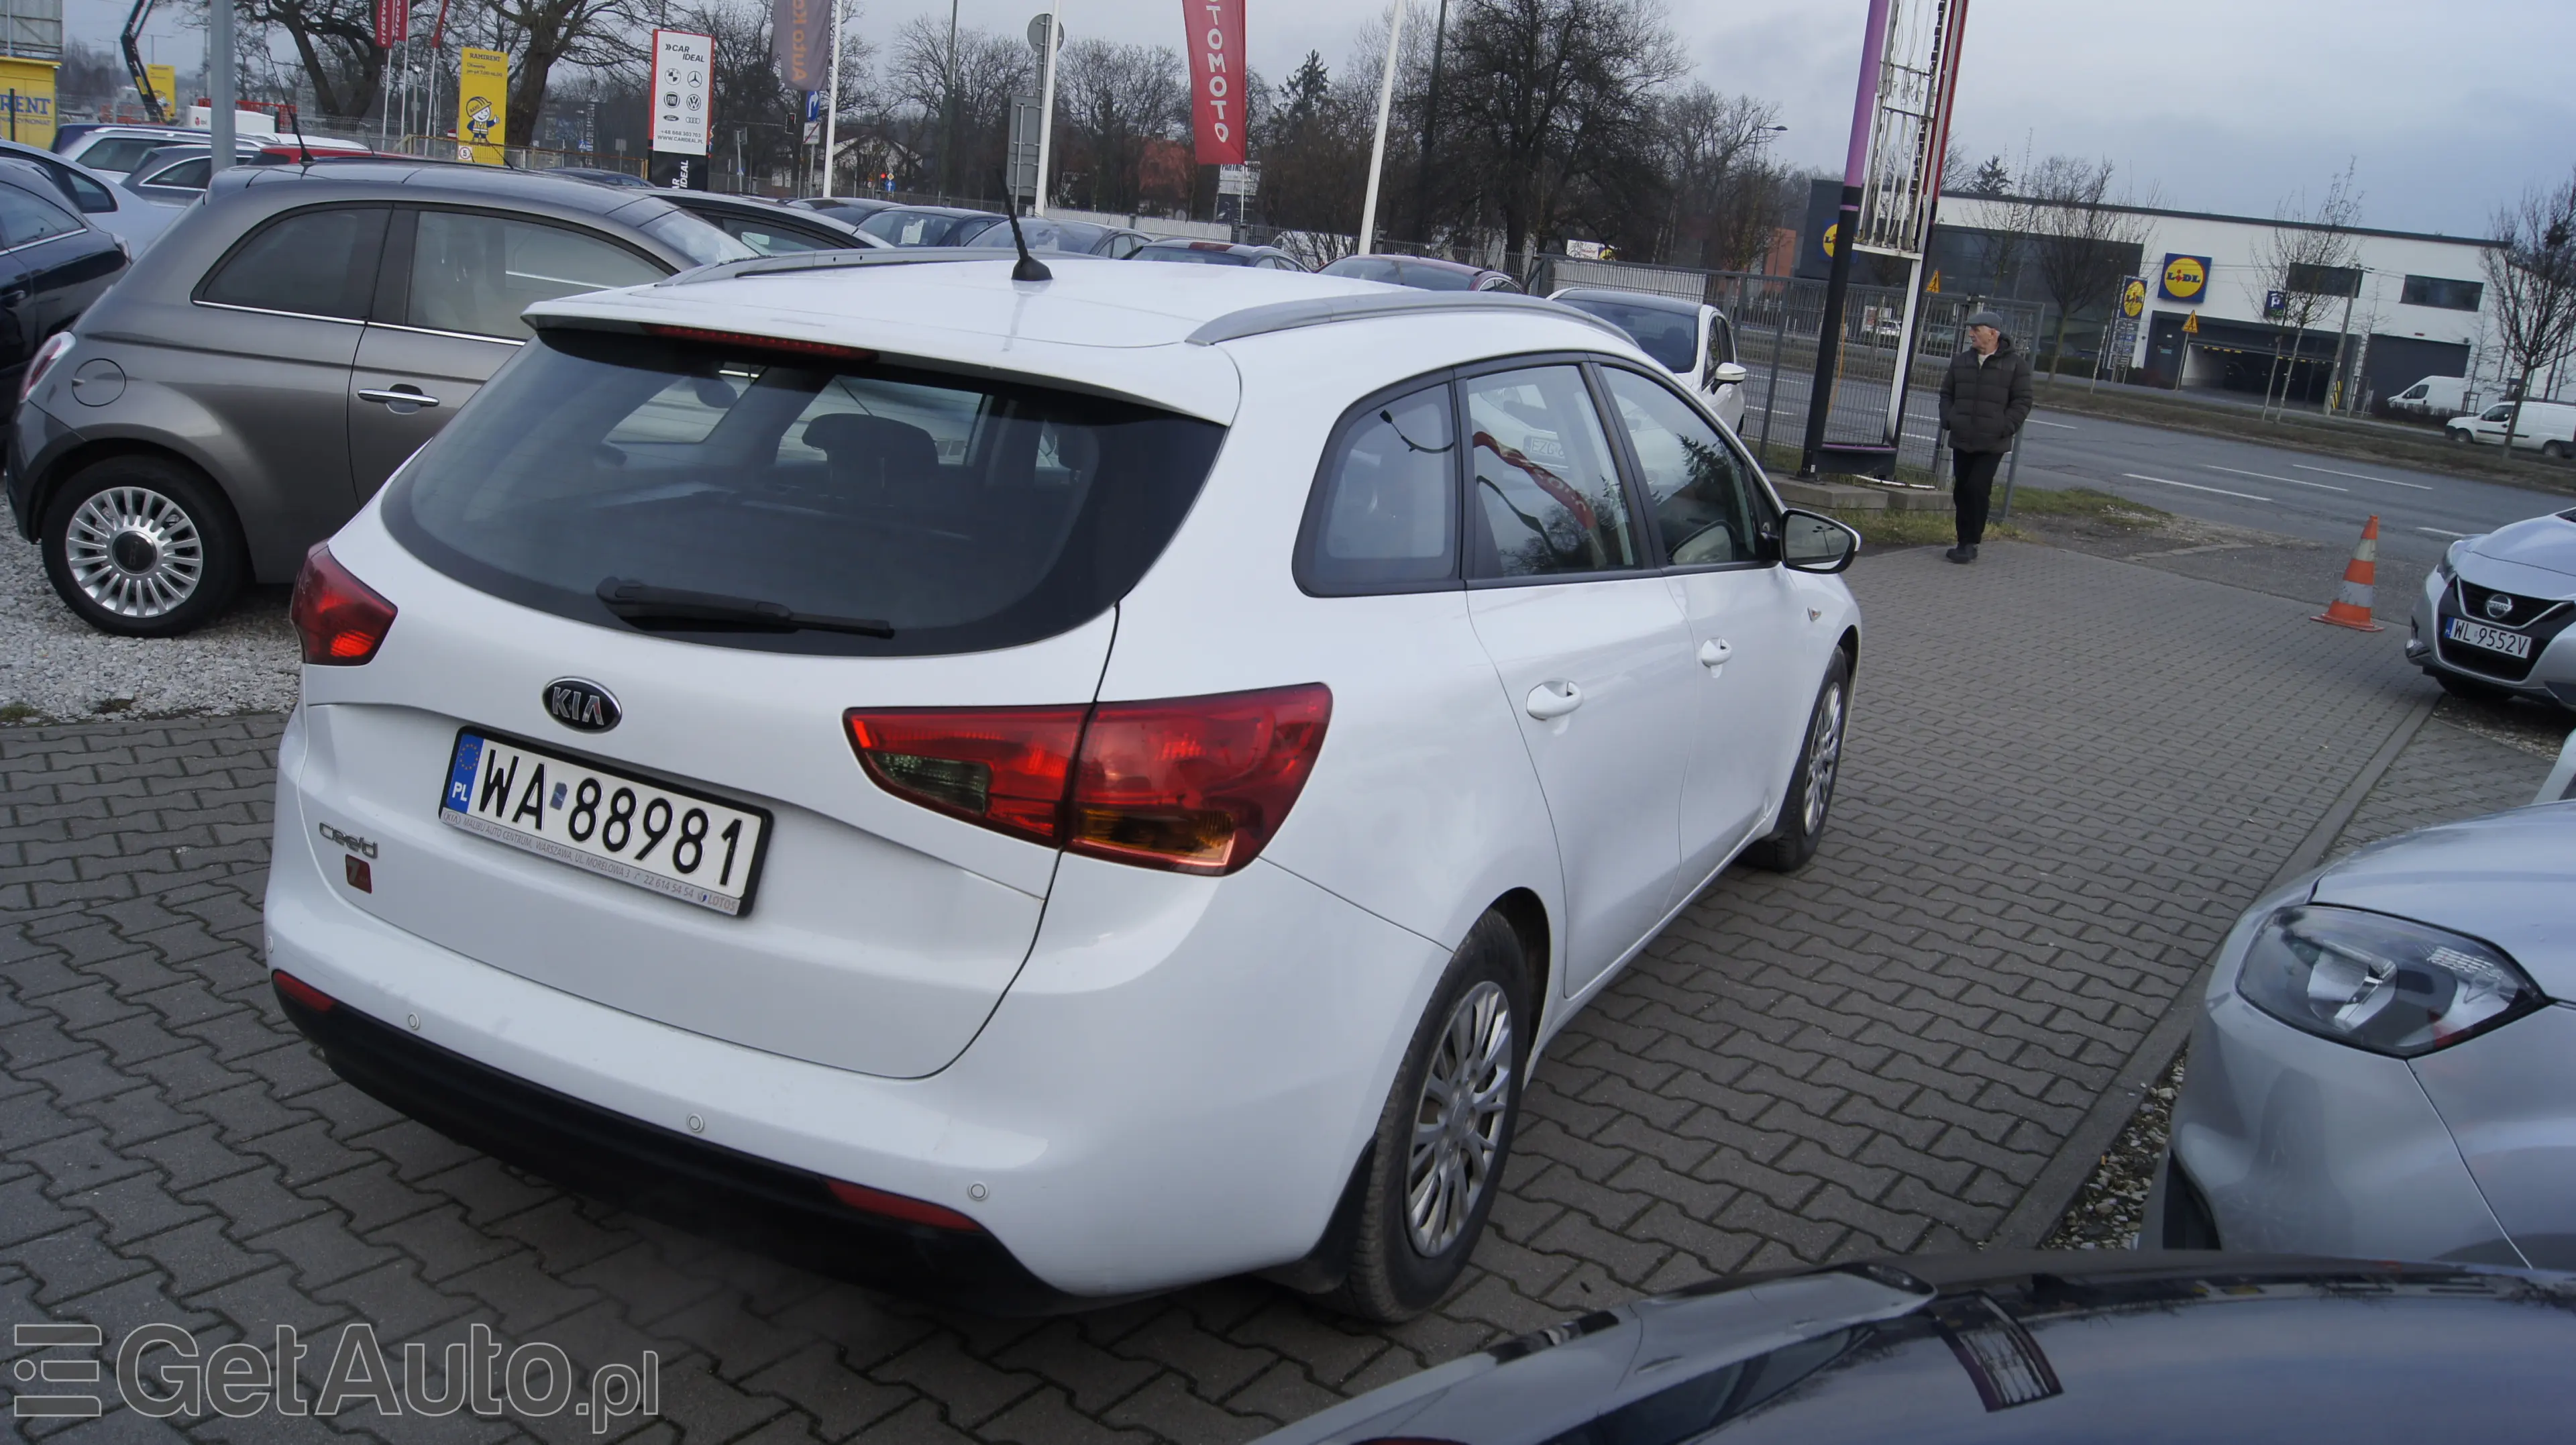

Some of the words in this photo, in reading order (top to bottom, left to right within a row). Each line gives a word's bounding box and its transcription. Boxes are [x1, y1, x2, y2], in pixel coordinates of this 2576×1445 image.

[470, 52, 501, 62] RAMIRENT
[672, 44, 690, 53] CAR
[682, 53, 704, 62] IDEAL
[1205, 0, 1229, 143] TOMOTO
[680, 160, 688, 189] IDEAL
[2454, 621, 2470, 641] WL
[2477, 628, 2528, 655] 9552V
[552, 686, 604, 725] KIA
[452, 782, 468, 802] PL
[444, 812, 459, 824] KIA
[478, 749, 546, 831] WA
[568, 776, 742, 886] 88981
[463, 818, 484, 832] MALIBU
[486, 825, 502, 838] AUTO
[586, 857, 624, 876] MORELOWA
[625, 869, 631, 877] 3
[643, 875, 654, 885] 22
[655, 878, 669, 890] 614
[672, 883, 682, 894] 54
[684, 886, 694, 898] 54
[346, 859, 360, 882] 7
[707, 894, 737, 912] LOTOS
